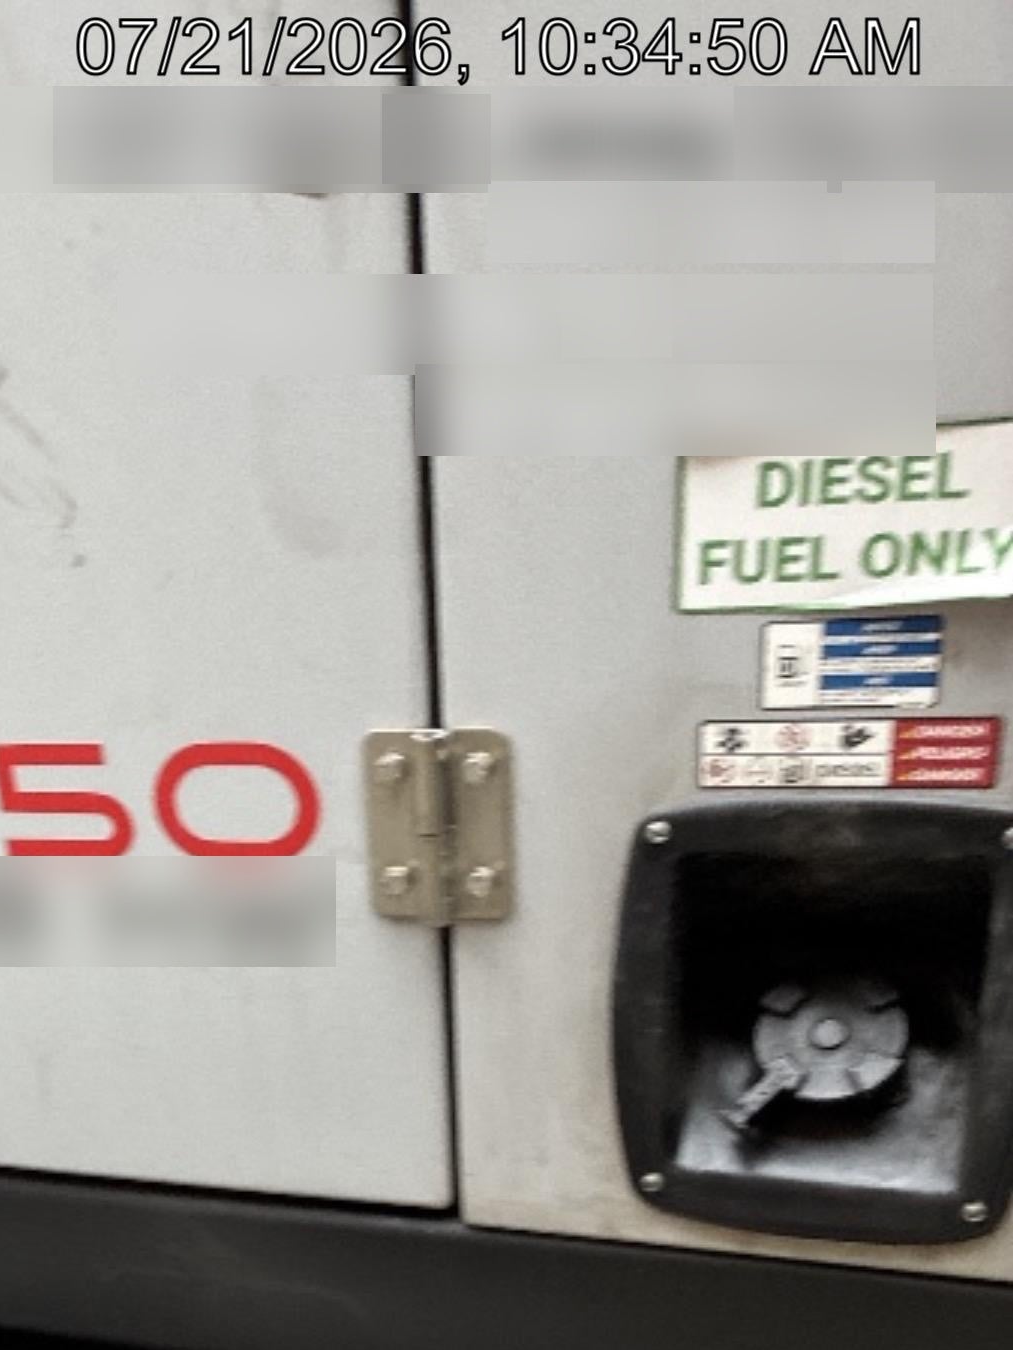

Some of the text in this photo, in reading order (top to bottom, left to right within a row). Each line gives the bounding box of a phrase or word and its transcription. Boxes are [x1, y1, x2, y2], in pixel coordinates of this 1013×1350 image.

[756, 453, 969, 507] DIESEL
[698, 528, 1013, 584] FUEL ONLY
